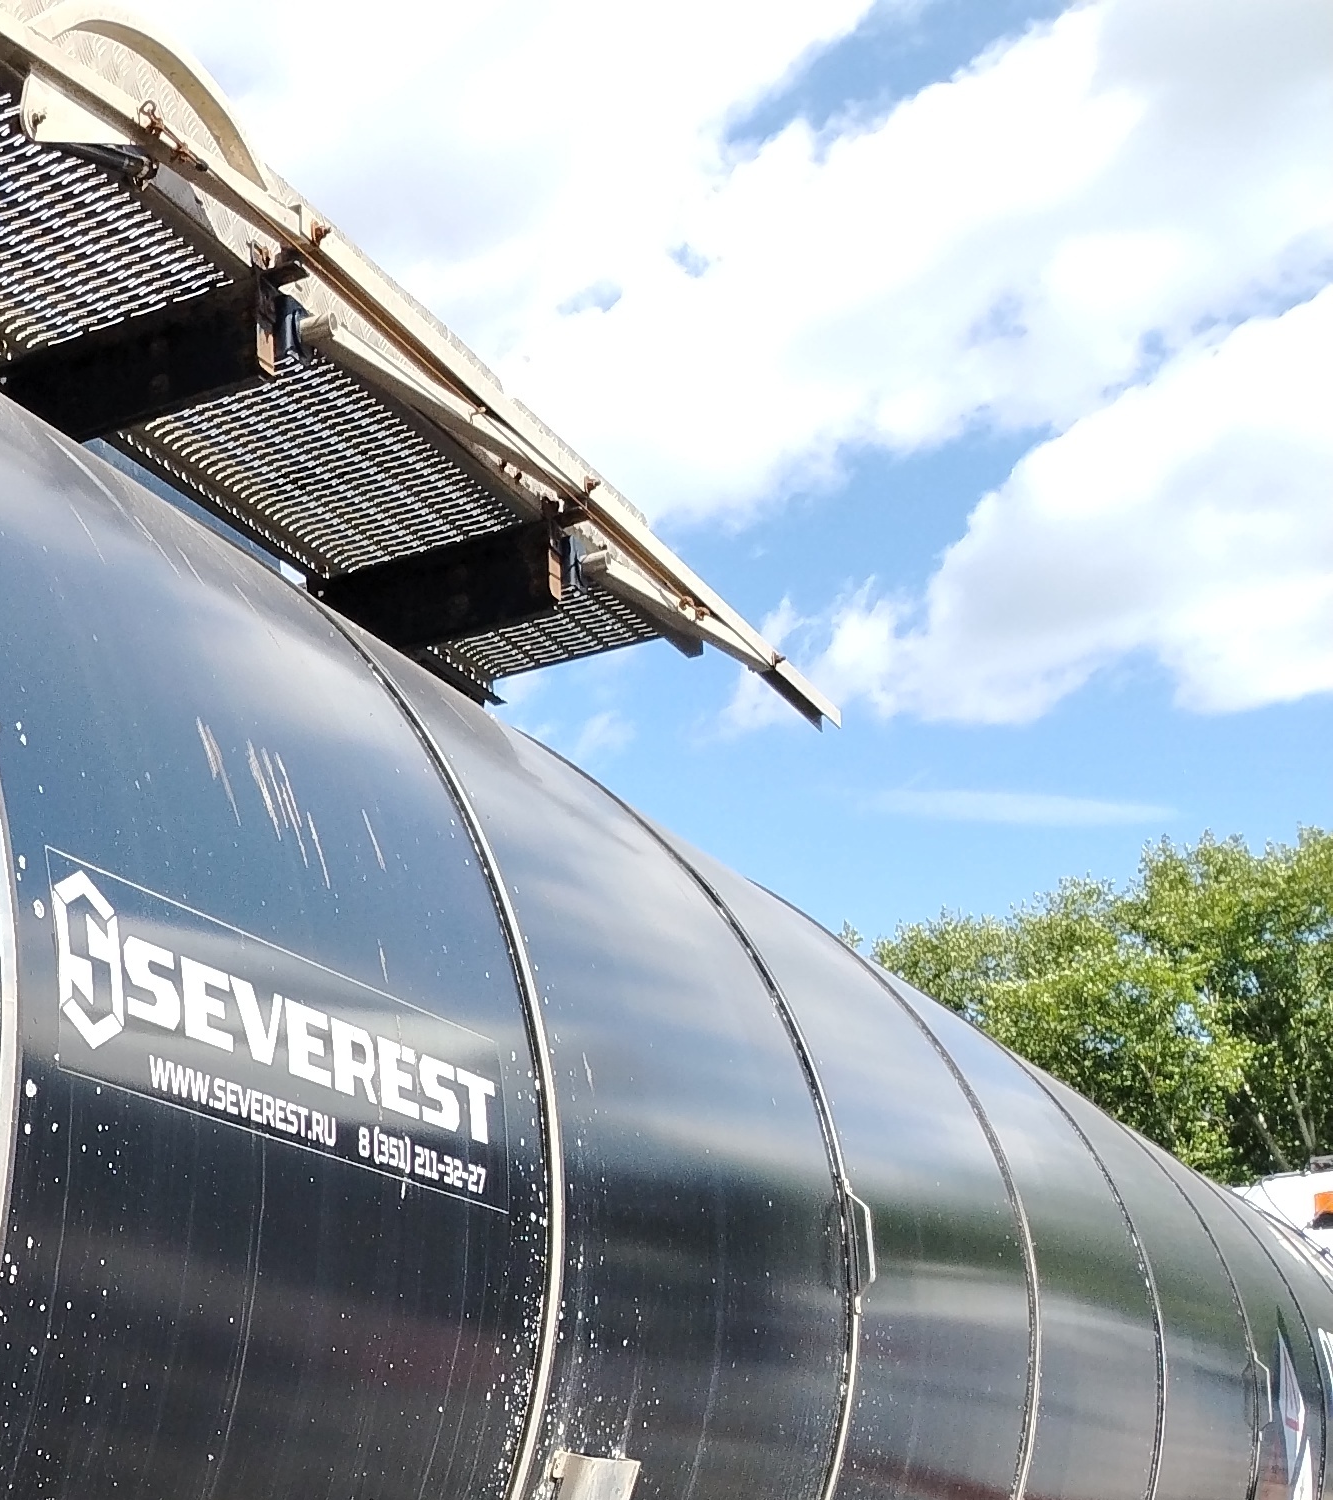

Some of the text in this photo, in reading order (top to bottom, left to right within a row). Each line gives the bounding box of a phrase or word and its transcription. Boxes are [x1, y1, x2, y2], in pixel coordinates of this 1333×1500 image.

[122, 934, 497, 1145] SEVEREST
[148, 1053, 488, 1196] WWW.SEVEREST.RU 8 (351) 211-32-27
